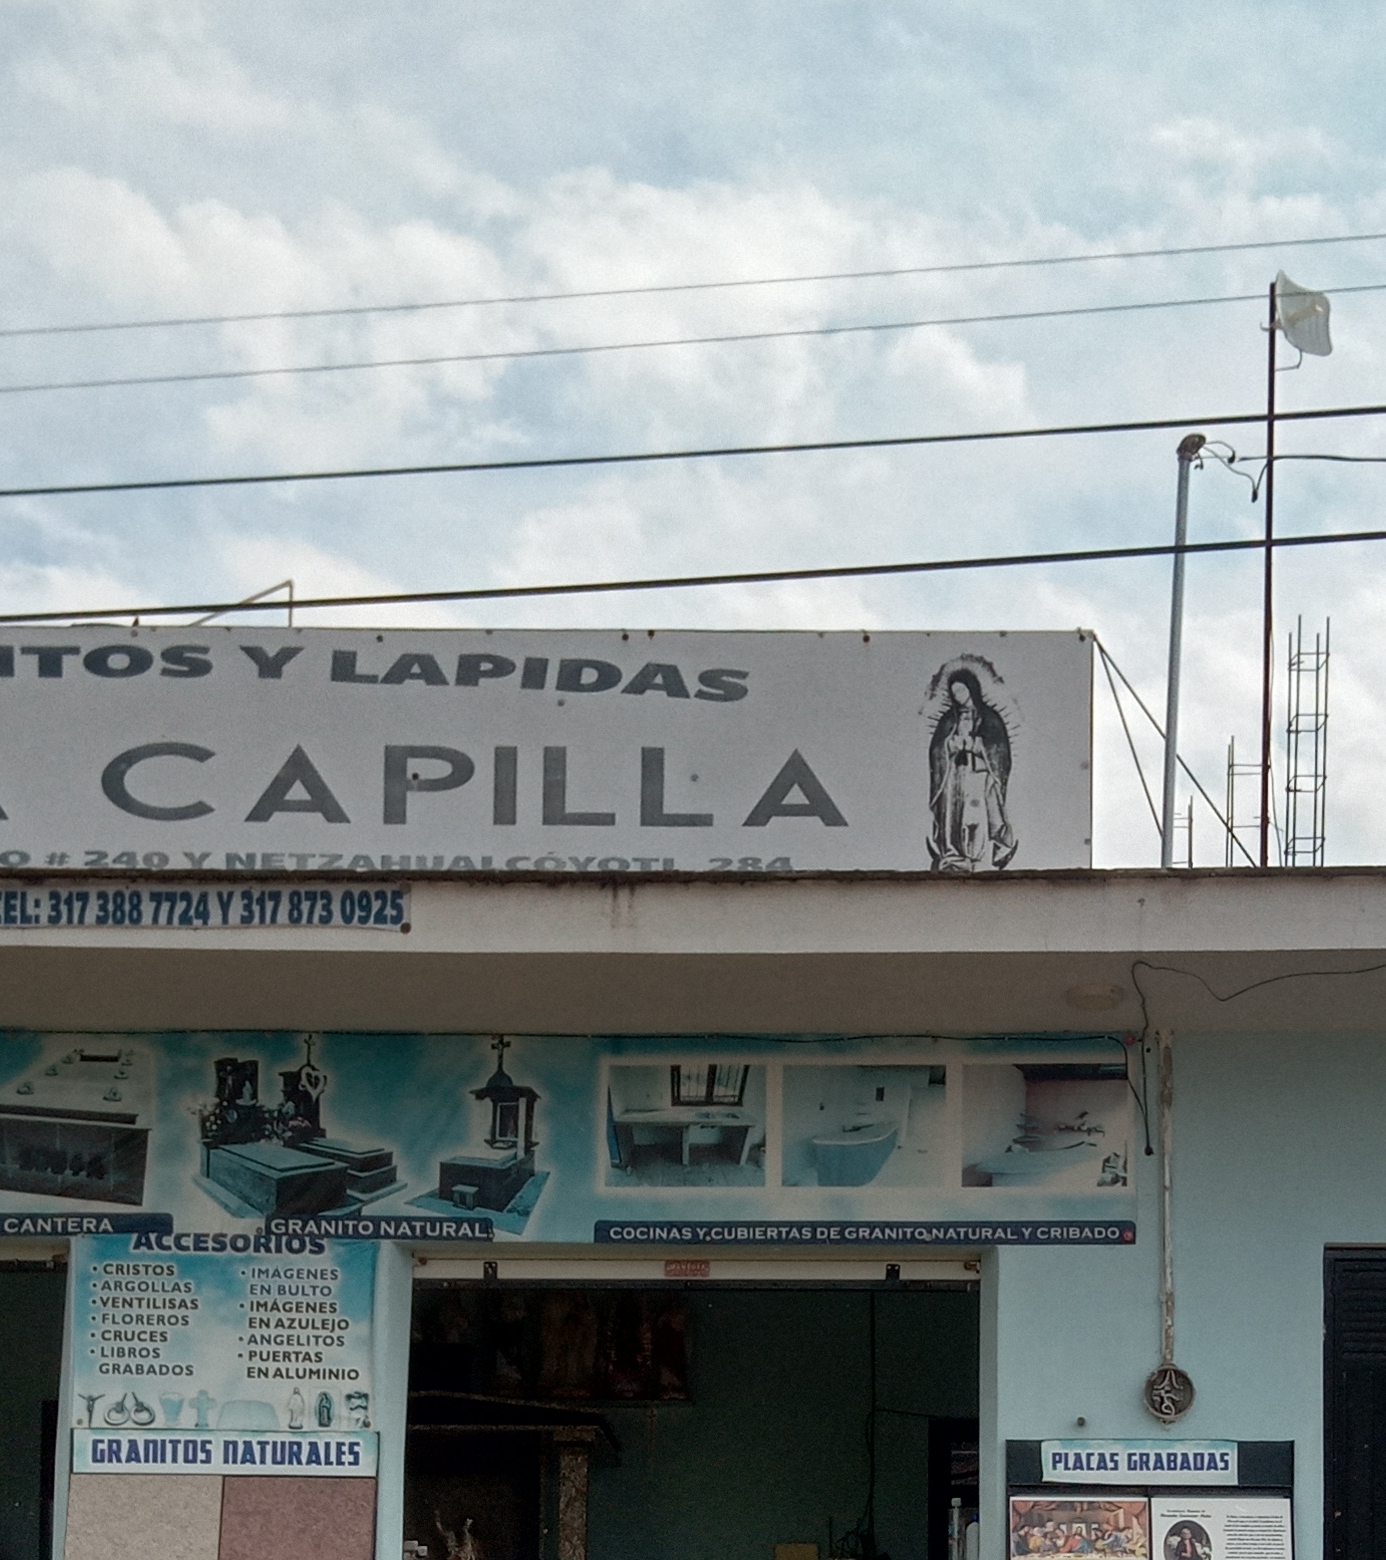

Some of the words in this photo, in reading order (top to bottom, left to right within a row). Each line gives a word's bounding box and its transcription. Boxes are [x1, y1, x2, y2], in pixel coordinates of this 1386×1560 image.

[239, 645, 304, 679] Y
[331, 648, 750, 703] LAPIDAS
[100, 740, 850, 829] CAPILLA
[83, 850, 170, 870] 240
[183, 851, 215, 870] Y
[708, 856, 793, 871] 284
[47, 890, 90, 925] 317
[95, 890, 144, 926] 388
[148, 890, 210, 926] 7724
[216, 890, 234, 925] Y
[240, 890, 282, 925] 317
[287, 890, 333, 925] 873
[339, 890, 404, 926] 0925
[3, 1217, 114, 1235] CANTERA
[271, 1218, 374, 1237] GRANITO
[379, 1220, 489, 1239] NATURAL
[609, 1226, 692, 1241] COCINAS
[695, 1226, 708, 1241] Y
[710, 1226, 812, 1241] CUBIERTAS
[816, 1226, 841, 1241] DE
[845, 1226, 928, 1241] GRANITO
[932, 1227, 1017, 1241] NATURAL
[1021, 1227, 1034, 1241] Y
[1036, 1226, 1121, 1241] CRIBADO
[132, 1232, 327, 1255] ACCESORIOS
[103, 1263, 176, 1277] CRISTOS
[251, 1266, 339, 1281] IMÁGENES
[101, 1280, 193, 1294] ARGOLLAS
[249, 1284, 274, 1297] EN
[277, 1284, 333, 1298] BULTO
[99, 1296, 200, 1311] VENTILISAS
[249, 1300, 338, 1315] IMÁGENES
[101, 1313, 190, 1327] FLOREROS
[248, 1317, 272, 1331] EN
[273, 1317, 350, 1333] AZULEJO
[101, 1329, 169, 1343] CRUCES
[247, 1334, 346, 1348] ANGELITOS
[100, 1346, 161, 1359] LIBROS
[247, 1351, 324, 1364] PUERTAS
[98, 1362, 195, 1377] GRABADOS
[246, 1366, 272, 1380] EN
[272, 1367, 360, 1381] ALUMINIO
[91, 1438, 213, 1464] GRANITOS
[223, 1440, 361, 1467] NATURALES
[1051, 1452, 1119, 1471] PLACAS
[1126, 1452, 1230, 1472] GRABADAS
